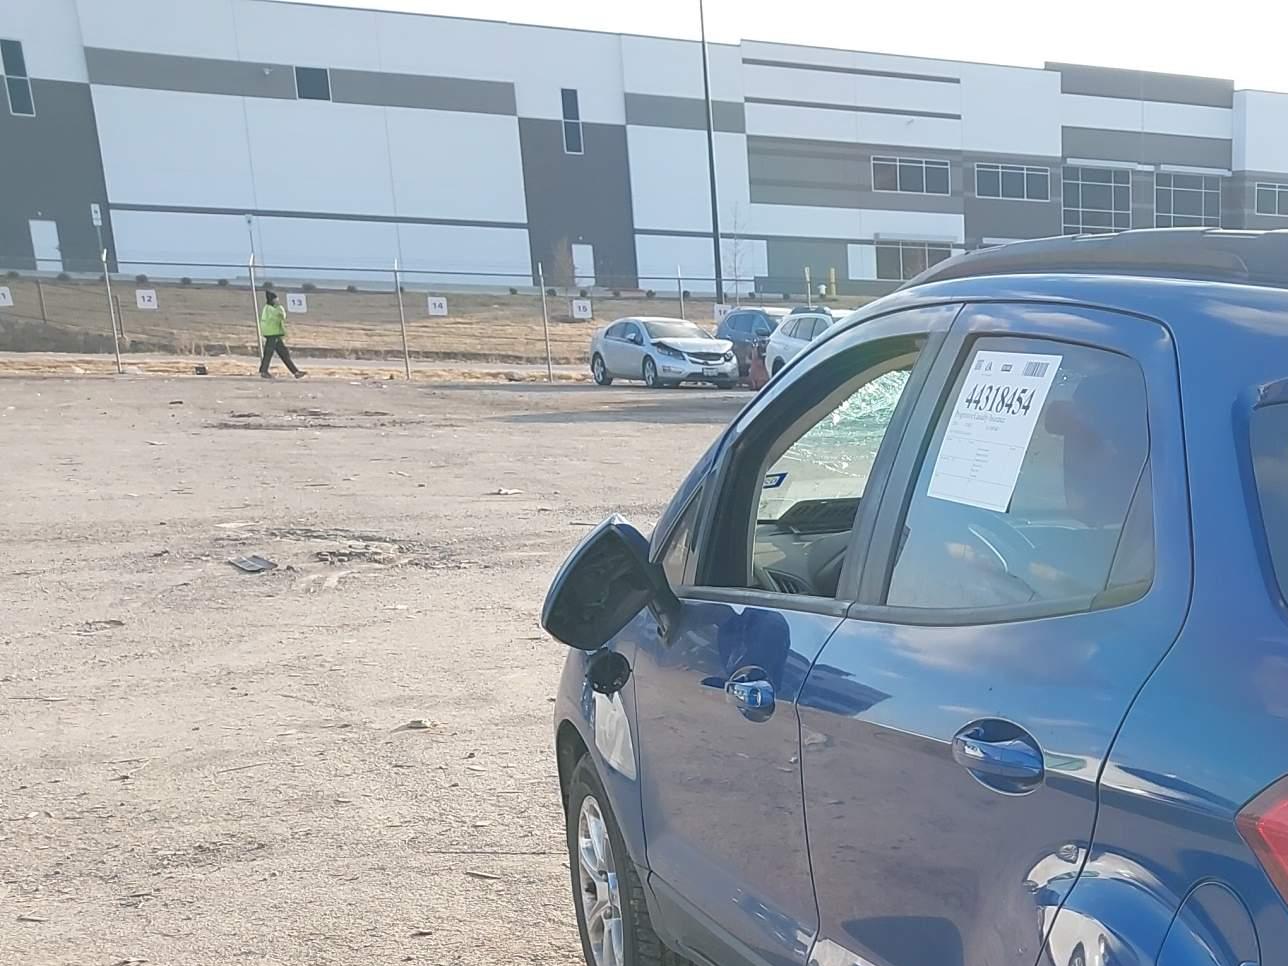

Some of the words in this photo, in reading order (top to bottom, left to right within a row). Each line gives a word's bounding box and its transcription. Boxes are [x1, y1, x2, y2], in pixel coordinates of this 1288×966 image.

[141, 295, 153, 303] 12
[291, 299, 303, 307] 13
[577, 305, 588, 313] 15
[965, 383, 1036, 416] 44318454
